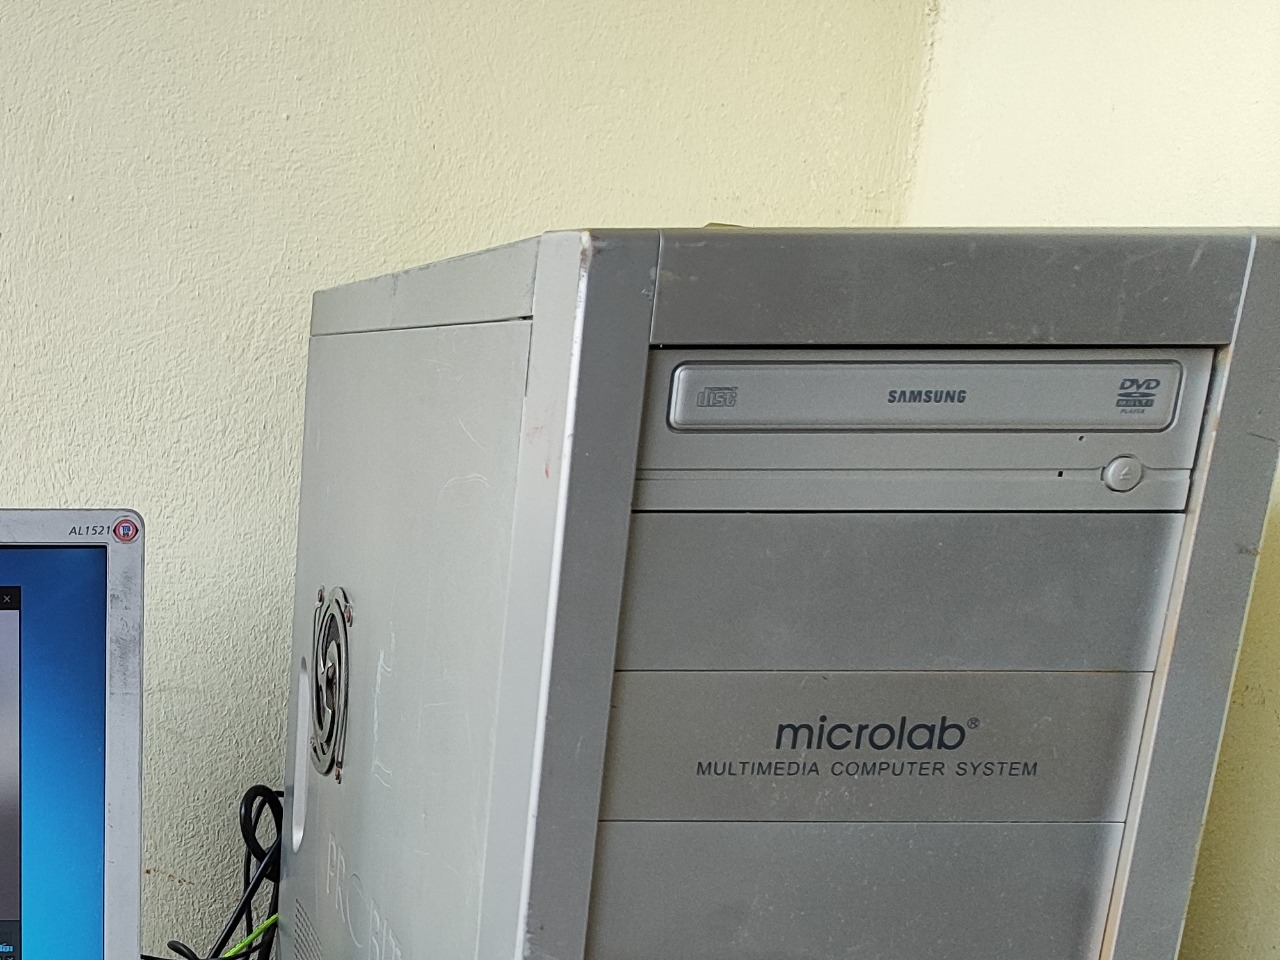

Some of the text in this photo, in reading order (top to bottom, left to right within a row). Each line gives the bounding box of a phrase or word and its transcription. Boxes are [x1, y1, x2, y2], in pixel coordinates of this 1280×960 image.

[1118, 378, 1161, 391] DVD
[887, 389, 967, 404] SAMSUNG
[68, 525, 111, 536] AL1521
[696, 760, 1039, 777] MULTIMEDIA COMPUTER SYSTEM
